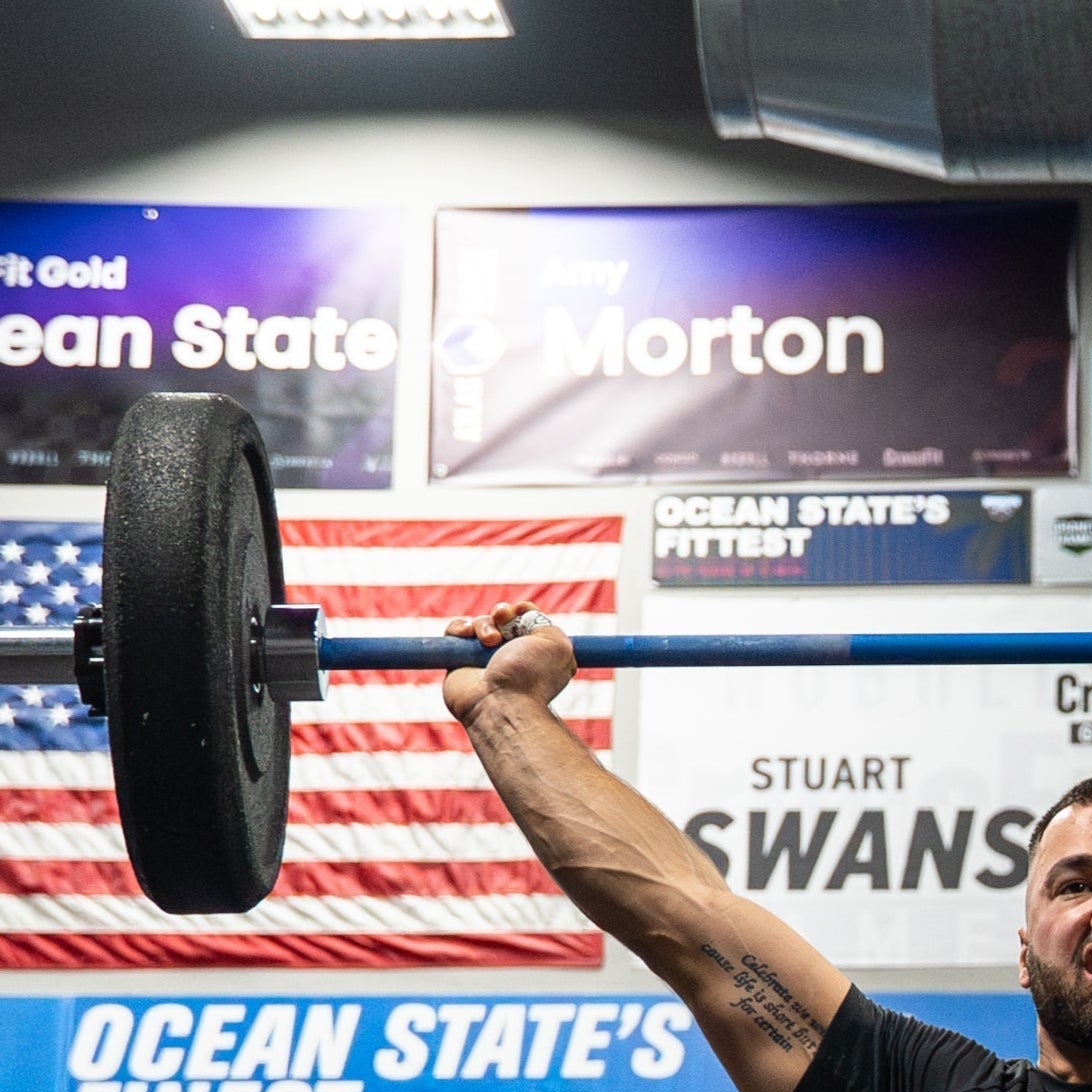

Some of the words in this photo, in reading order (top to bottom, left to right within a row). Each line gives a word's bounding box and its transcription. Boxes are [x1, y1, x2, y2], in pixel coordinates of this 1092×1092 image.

[36, 254, 128, 290] Gold
[541, 255, 630, 296] Amy
[171, 303, 400, 371] State
[540, 304, 885, 377] Morton
[654, 495, 790, 527] OCEAN
[797, 495, 951, 526] STATE'S
[654, 527, 812, 558] FITTEST
[751, 756, 911, 791] STUART
[684, 808, 1037, 892] SWANS
[729, 998, 757, 1017] for
[733, 971, 757, 993] life
[753, 988, 767, 1004] is
[764, 1004, 796, 1031] short
[66, 1002, 362, 1081] OCEAN
[372, 1002, 690, 1079] STATE'S
